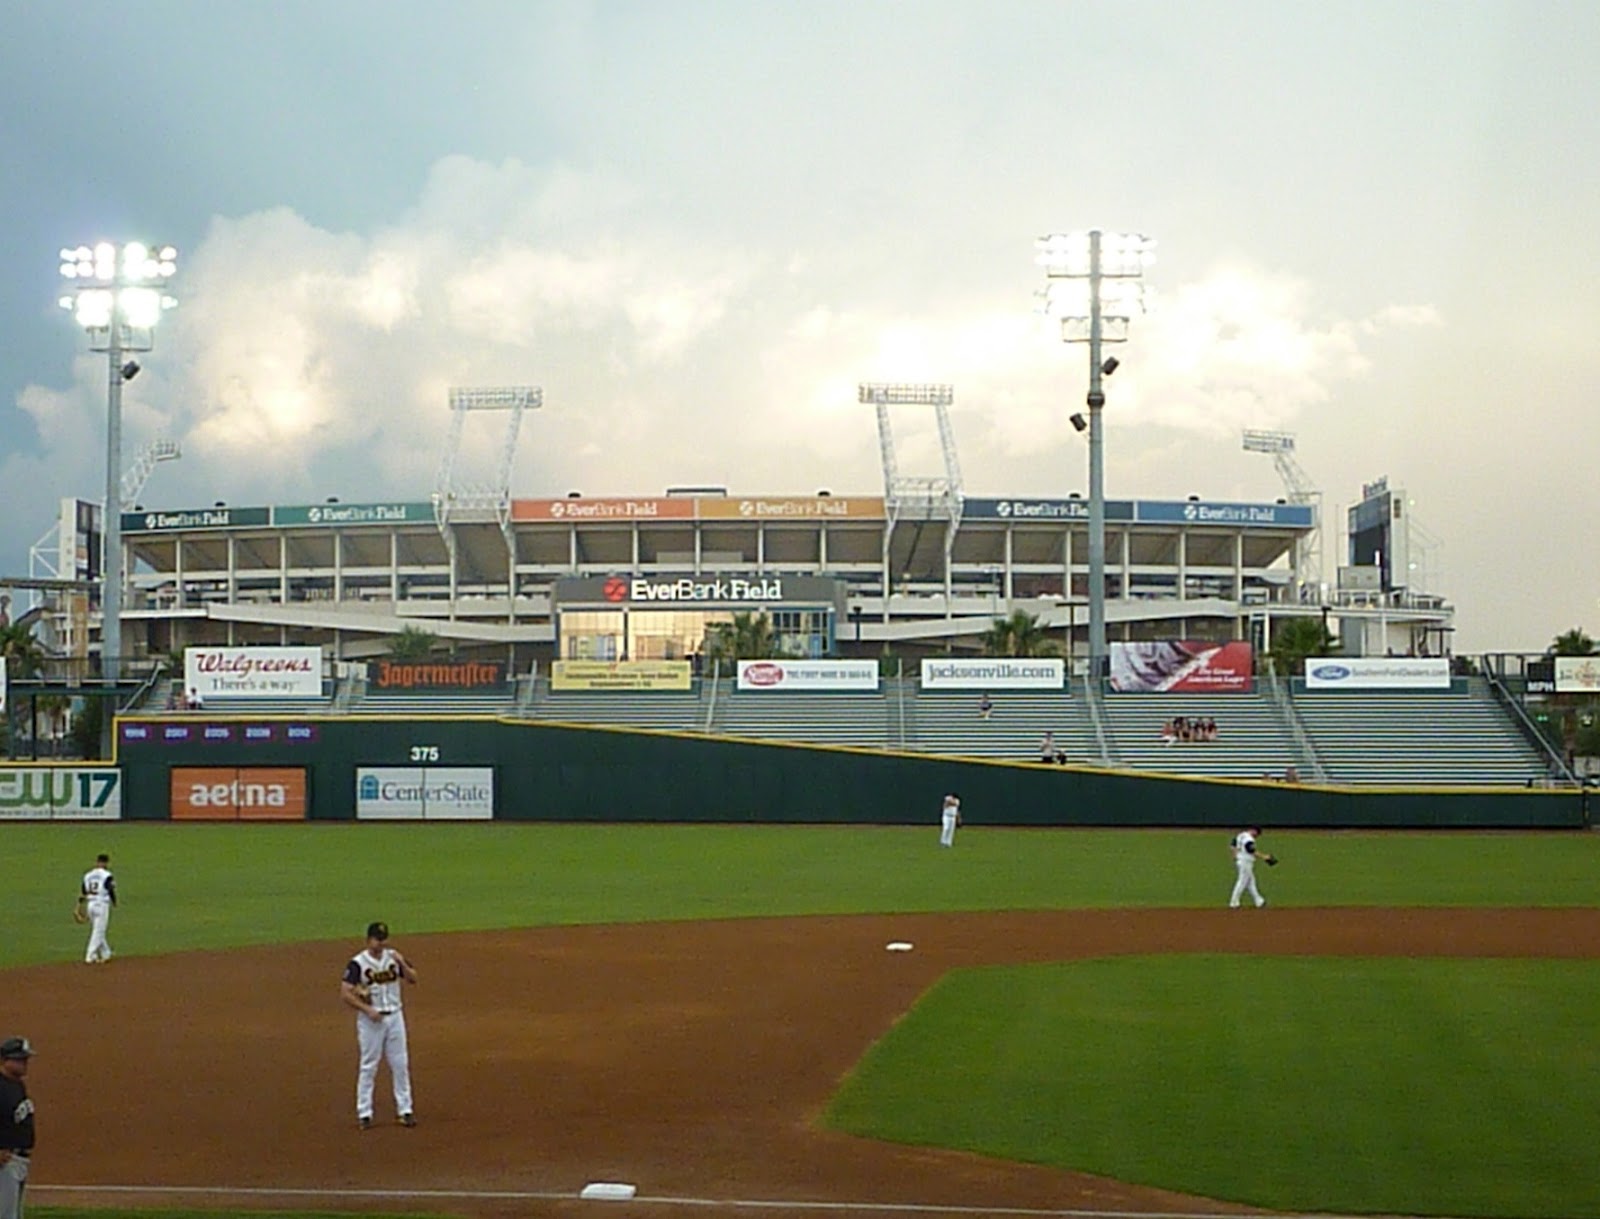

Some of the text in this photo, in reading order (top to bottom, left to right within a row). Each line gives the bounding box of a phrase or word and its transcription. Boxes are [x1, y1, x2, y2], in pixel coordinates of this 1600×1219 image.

[376, 506, 406, 519] Field
[625, 502, 657, 516] Field
[816, 501, 848, 515] Field
[1069, 503, 1089, 516] Fie
[1249, 507, 1275, 521] Field
[203, 510, 229, 525] Field
[631, 579, 783, 600] EverBank Field
[196, 652, 312, 678] Walgreens
[213, 678, 295, 693] There's a way
[410, 746, 440, 761] 375
[77, 773, 118, 808] 17
[189, 781, 286, 806] aetna
[382, 781, 490, 802] CenterState
